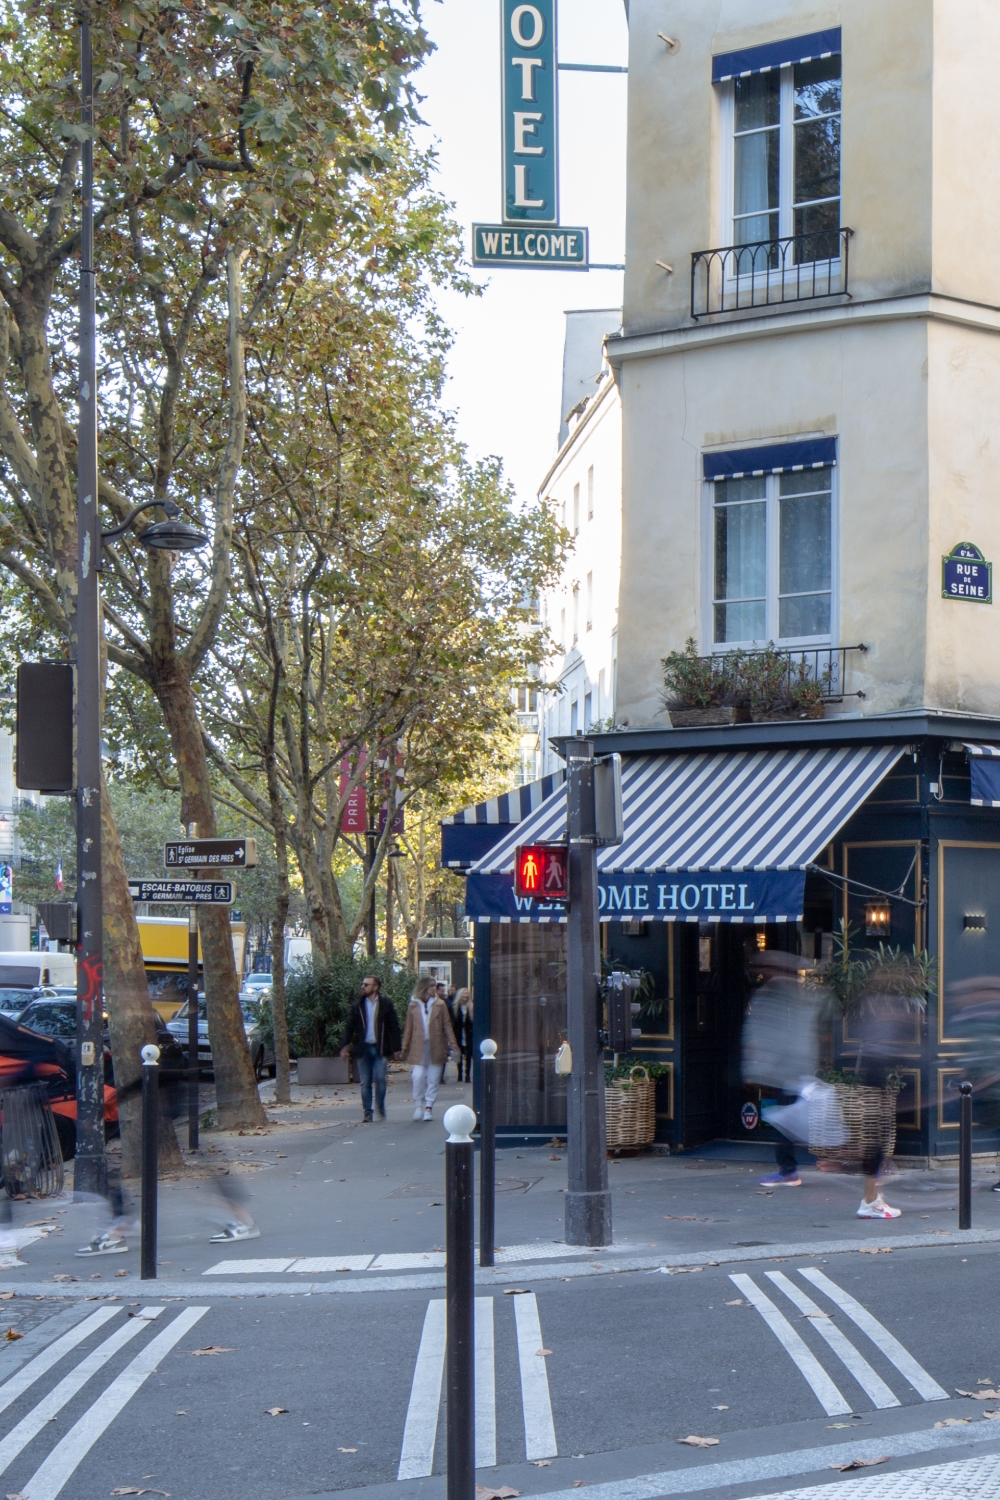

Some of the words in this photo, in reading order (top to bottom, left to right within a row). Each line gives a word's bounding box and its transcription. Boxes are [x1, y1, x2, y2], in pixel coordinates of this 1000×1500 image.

[481, 232, 577, 257] WELCOME
[956, 564, 978, 576] RUE
[951, 583, 984, 597] SEINE
[178, 845, 195, 855] Eglise
[184, 855, 207, 863] GERMAIN
[208, 854, 220, 863] DES
[220, 854, 235, 863] PRES
[141, 883, 212, 892] ESCALE-BATOBUS
[657, 884, 755, 910] HOTEL
